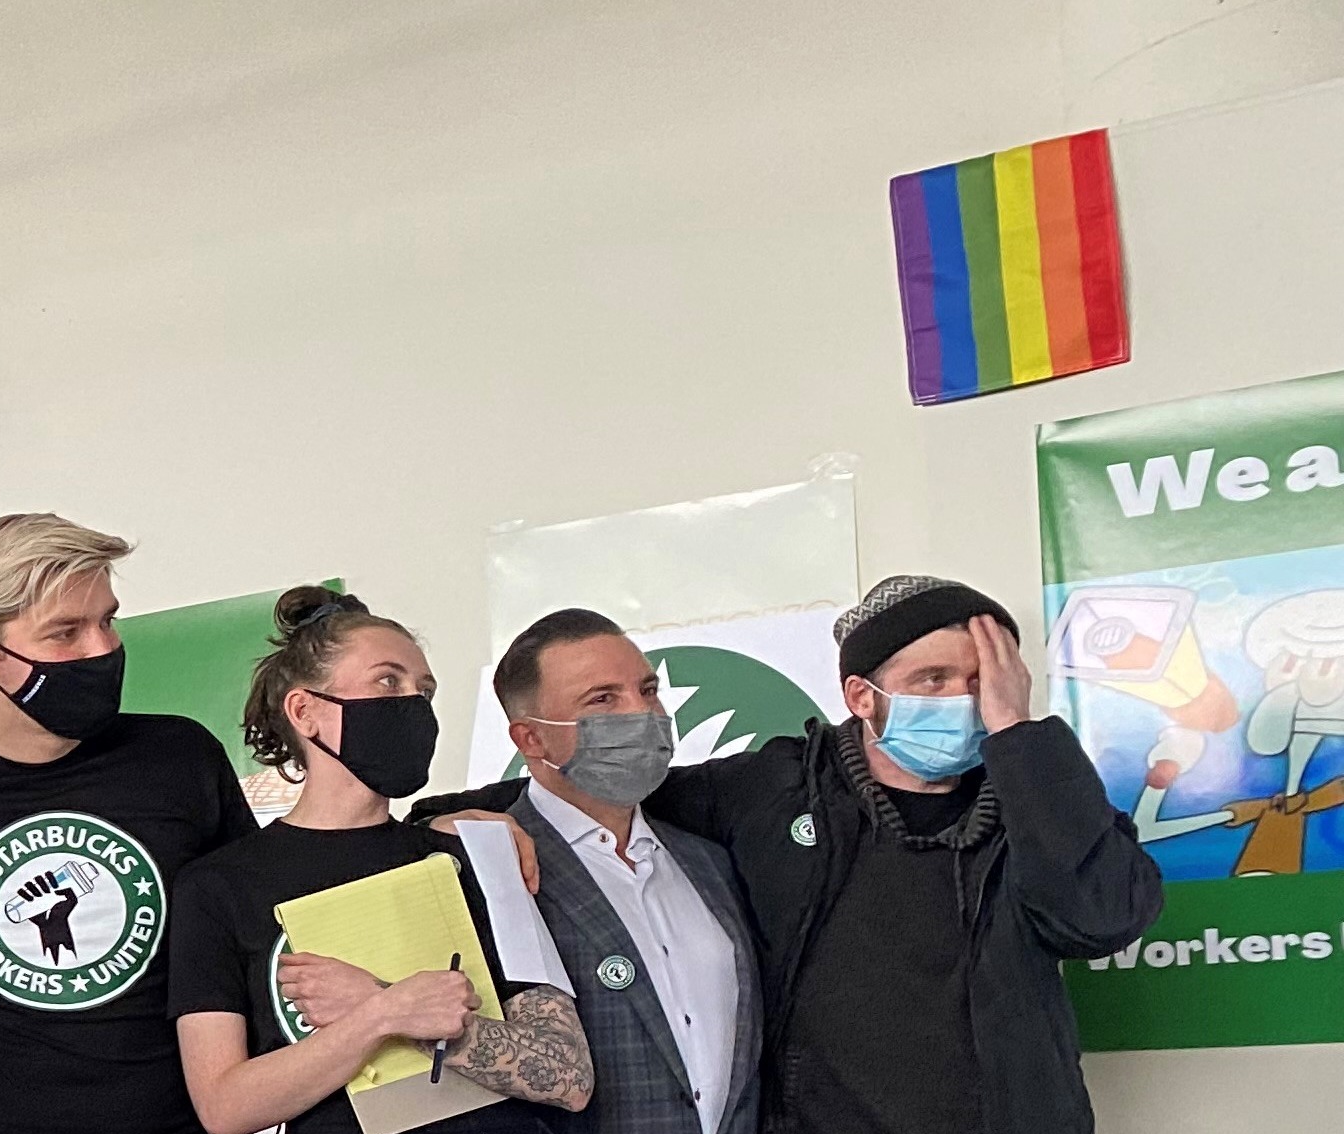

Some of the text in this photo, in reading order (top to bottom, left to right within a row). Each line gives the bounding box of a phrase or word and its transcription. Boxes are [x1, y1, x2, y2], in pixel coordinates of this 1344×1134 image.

[1106, 444, 1344, 519] We a
[87, 904, 157, 985] UNITED
